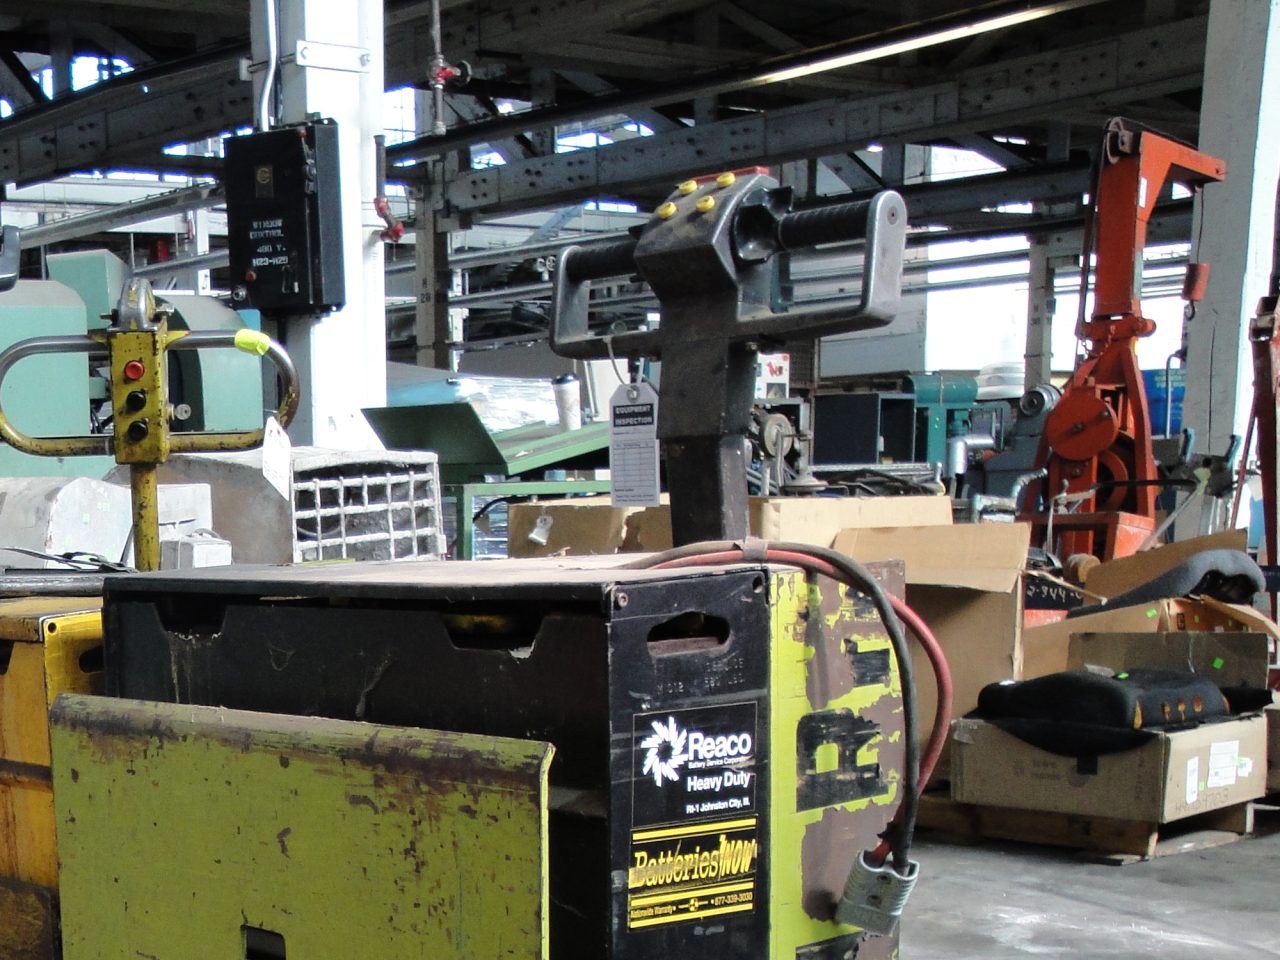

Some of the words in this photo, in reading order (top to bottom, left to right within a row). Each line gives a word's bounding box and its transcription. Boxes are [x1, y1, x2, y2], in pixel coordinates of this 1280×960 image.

[615, 405, 651, 414] EQUIPMENT
[616, 416, 652, 426] INSPECTION
[688, 731, 752, 761] Reaco
[687, 775, 723, 792] Heavy
[723, 771, 751, 788] Duty
